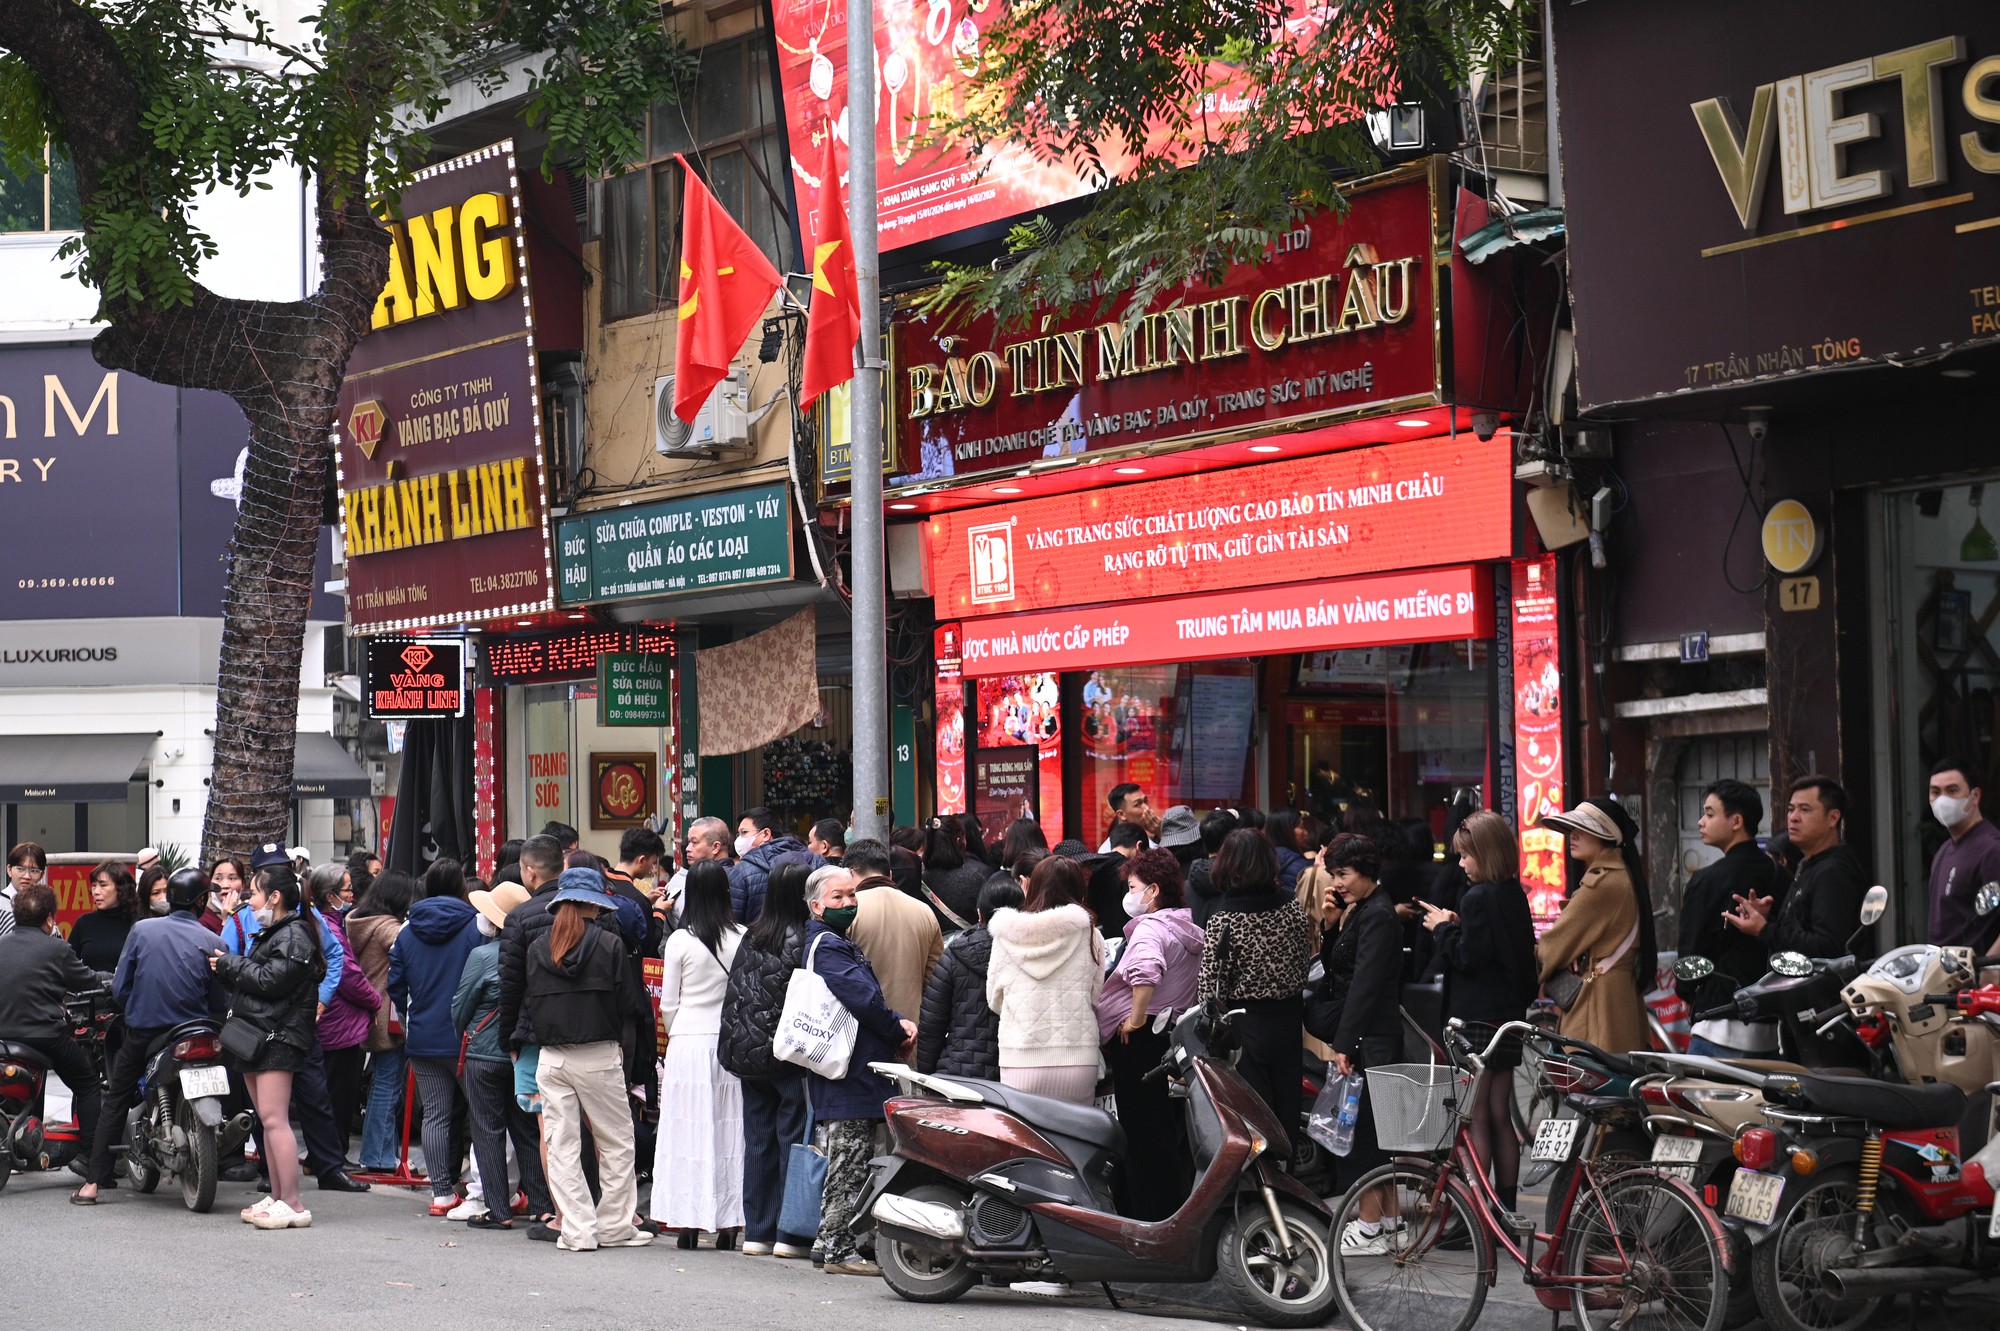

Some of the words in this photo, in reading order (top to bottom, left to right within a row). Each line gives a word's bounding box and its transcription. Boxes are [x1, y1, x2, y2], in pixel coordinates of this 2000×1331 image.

[908, 335, 997, 419] BẢO
[1005, 314, 1086, 397] TÍN
[1095, 294, 1249, 381] MINH
[1250, 242, 1420, 351] CHÂU
[1684, 365, 1700, 384] 17
[1704, 352, 1750, 381] TRẦN
[1756, 345, 1804, 373] NHÂN
[1812, 337, 1861, 363] TÔNG
[410, 390, 442, 409] CÔNG
[444, 384, 459, 400] TY
[462, 377, 493, 397] TNHH
[398, 412, 431, 447] VÀNG
[434, 408, 460, 444] BẠC
[463, 399, 482, 434] ĐÁ
[484, 391, 510, 432] QUÝ
[955, 440, 983, 461] KINH
[985, 431, 1029, 456] DOANH
[1086, 411, 1120, 438] VÀNG
[1217, 387, 1266, 415] TRANG
[1270, 376, 1300, 405] SỨC
[1304, 371, 1328, 398] MỸ
[1330, 361, 1374, 393] NGHỆ
[354, 411, 382, 446] KL
[343, 459, 445, 557] KHÁNH
[448, 457, 529, 540] LINH
[596, 518, 617, 544] SỬA
[618, 515, 647, 539] CHỮA
[649, 511, 692, 536] COMPLE
[701, 503, 745, 528] VESTON
[756, 493, 780, 520] VÁY
[1026, 527, 1063, 551] VÀNG
[1065, 523, 1112, 546] TRANG
[1113, 514, 1143, 540] SỨC
[1188, 505, 1241, 530] LƯỢNG
[1243, 499, 1278, 523] CAO
[1280, 490, 1314, 518] BẢO
[1316, 485, 1344, 513] TÍN
[1347, 481, 1393, 508] MINH
[1395, 471, 1444, 501] CHÂU
[564, 536, 586, 557] ĐỨC
[1104, 551, 1143, 576] RẠNG
[1169, 542, 1190, 569] TỰ
[1191, 541, 1223, 563] TIN,
[1224, 533, 1254, 559] GIỮ
[1256, 529, 1285, 555] GÌN
[1287, 524, 1314, 550] TÀI
[1317, 521, 1349, 547] SẢN
[1768, 518, 1809, 554] TN
[627, 541, 662, 573] QUẦN
[667, 540, 686, 564] ÁO
[689, 536, 714, 562] CÁC
[719, 535, 749, 560] LOẠI
[565, 562, 587, 588] HẬU
[617, 584, 624, 594] 13
[767, 564, 781, 575] 7314
[356, 595, 364, 610] 11
[386, 585, 406, 607] NHÂN
[407, 584, 428, 604] TÔNG
[1789, 582, 1811, 606] 17
[991, 630, 1020, 656] NHÀ
[1022, 627, 1061, 653] NƯỚC
[1093, 619, 1130, 647] PHÉP
[1176, 614, 1228, 640] TRUNG
[1230, 606, 1263, 634] TÂM
[1266, 607, 1303, 631] MUA
[1305, 598, 1339, 628] BÁN
[1342, 595, 1389, 624] VÀNG
[488, 639, 543, 676] VÀNG
[612, 659, 635, 673] ĐỨC
[639, 661, 663, 676] HẬU
[390, 668, 445, 688] VÀNG
[612, 677, 634, 690] SỬA
[635, 676, 663, 690] CHỮA
[375, 687, 423, 709] KHÁNH
[427, 690, 459, 709] LINH
[634, 694, 658, 708] HIỆU
[624, 710, 666, 720] 0984997314
[528, 751, 568, 779] TRANG
[683, 749, 696, 768] SỬA
[896, 744, 910, 762] 13
[24, 788, 48, 797] Maison
[48, 788, 56, 796] M
[535, 778, 560, 808] SỨC
[793, 1018, 835, 1043] Galaxy
[1768, 1074, 1798, 1082] HONDA
[916, 1118, 970, 1135] LEAD
[1728, 1193, 1773, 1221] 081.53
